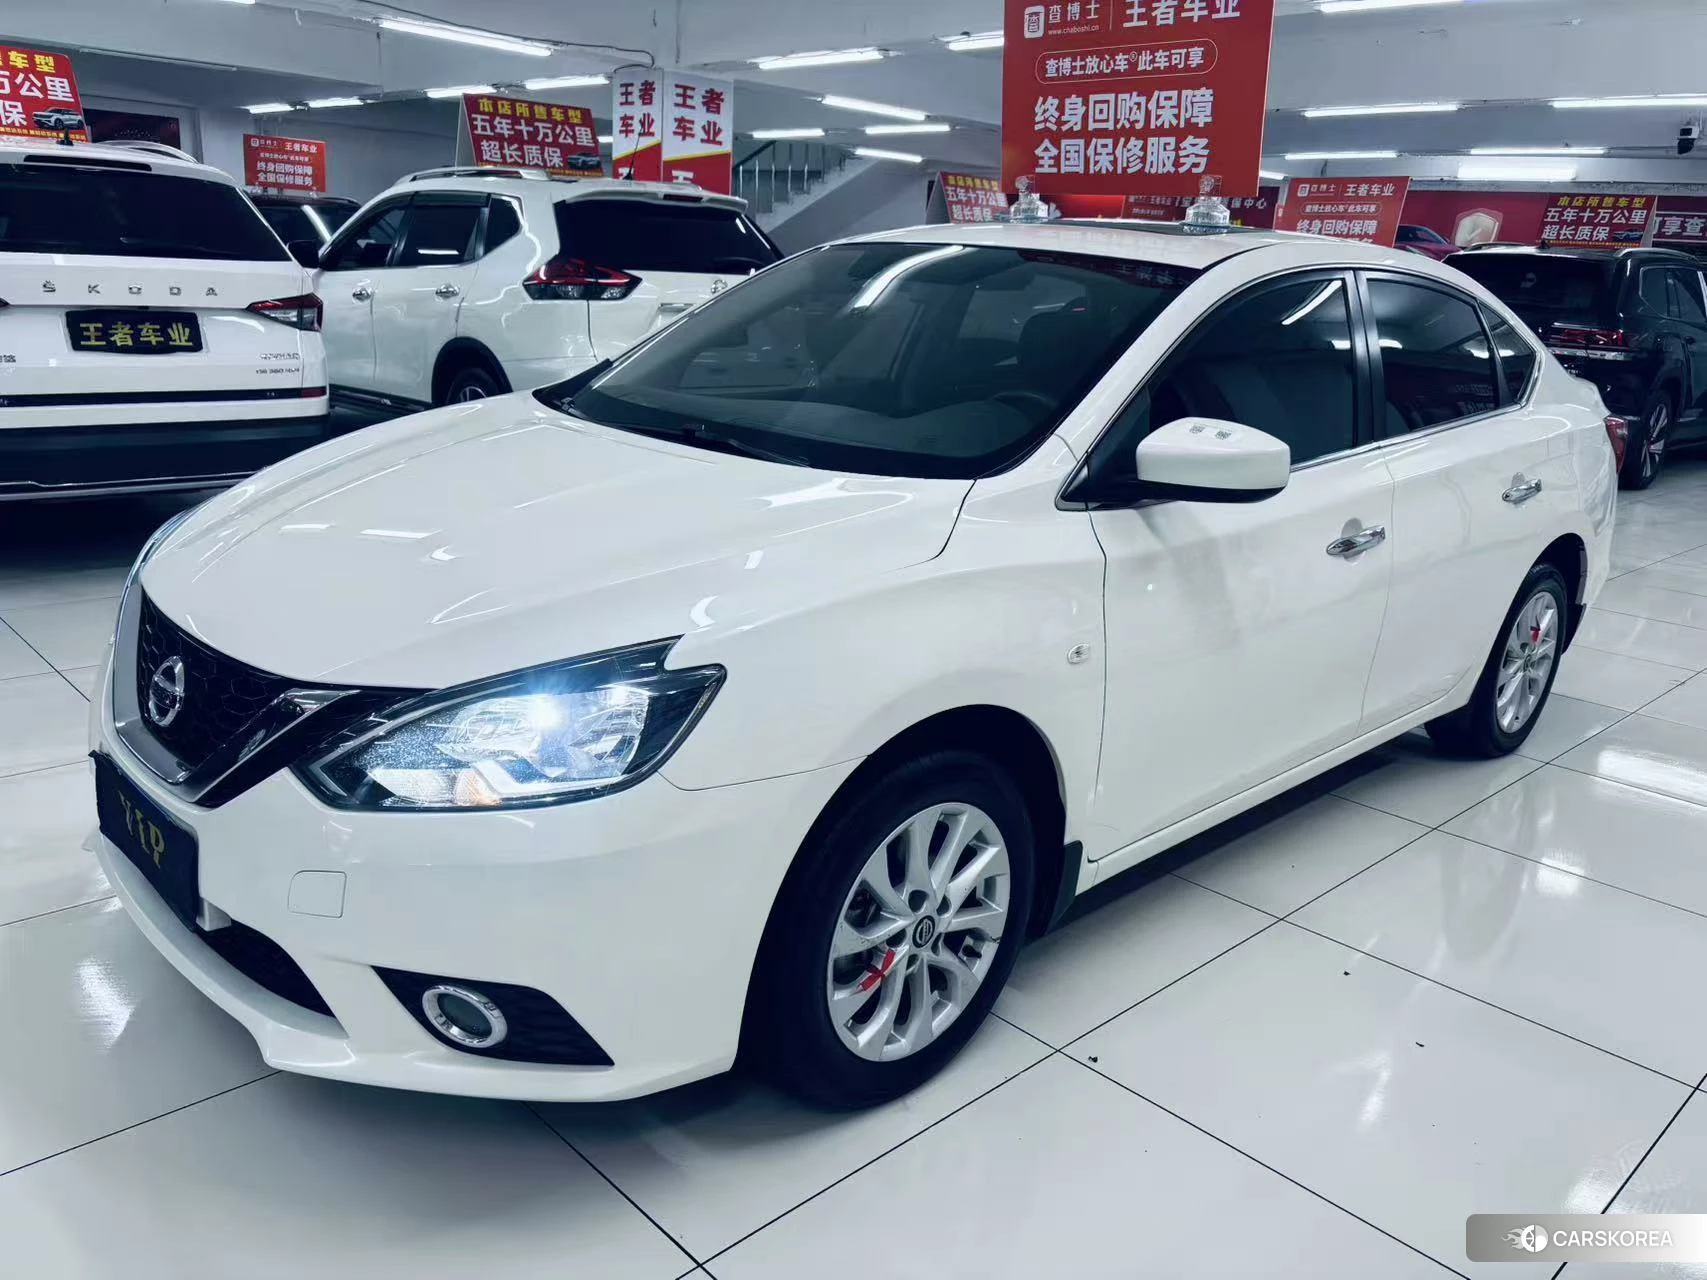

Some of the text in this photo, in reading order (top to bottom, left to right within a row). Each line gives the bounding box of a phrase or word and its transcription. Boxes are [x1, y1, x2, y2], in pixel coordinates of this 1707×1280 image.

[1048, 0, 1100, 23] 查博士
[1123, 0, 1240, 27] 王者车业
[0, 50, 56, 73] 车型
[619, 80, 656, 106] 王者
[674, 84, 725, 115] 王者
[478, 97, 583, 124] 本店所售车型
[1034, 87, 1214, 132] 终身回购保障
[471, 113, 596, 147] 五年十万公里
[619, 113, 656, 138] 车业
[672, 115, 723, 146] 车业
[480, 139, 564, 168] 超长质保
[1034, 135, 1210, 174] 全国保修服务
[1344, 183, 1395, 197] 王者车业
[1557, 196, 1646, 208] 本店所售车型
[1296, 219, 1378, 236] 终身回购保障
[1543, 207, 1648, 225] 五年十万公里
[1541, 224, 1611, 241] 超长质保
[79, 320, 193, 347] 王者车业
